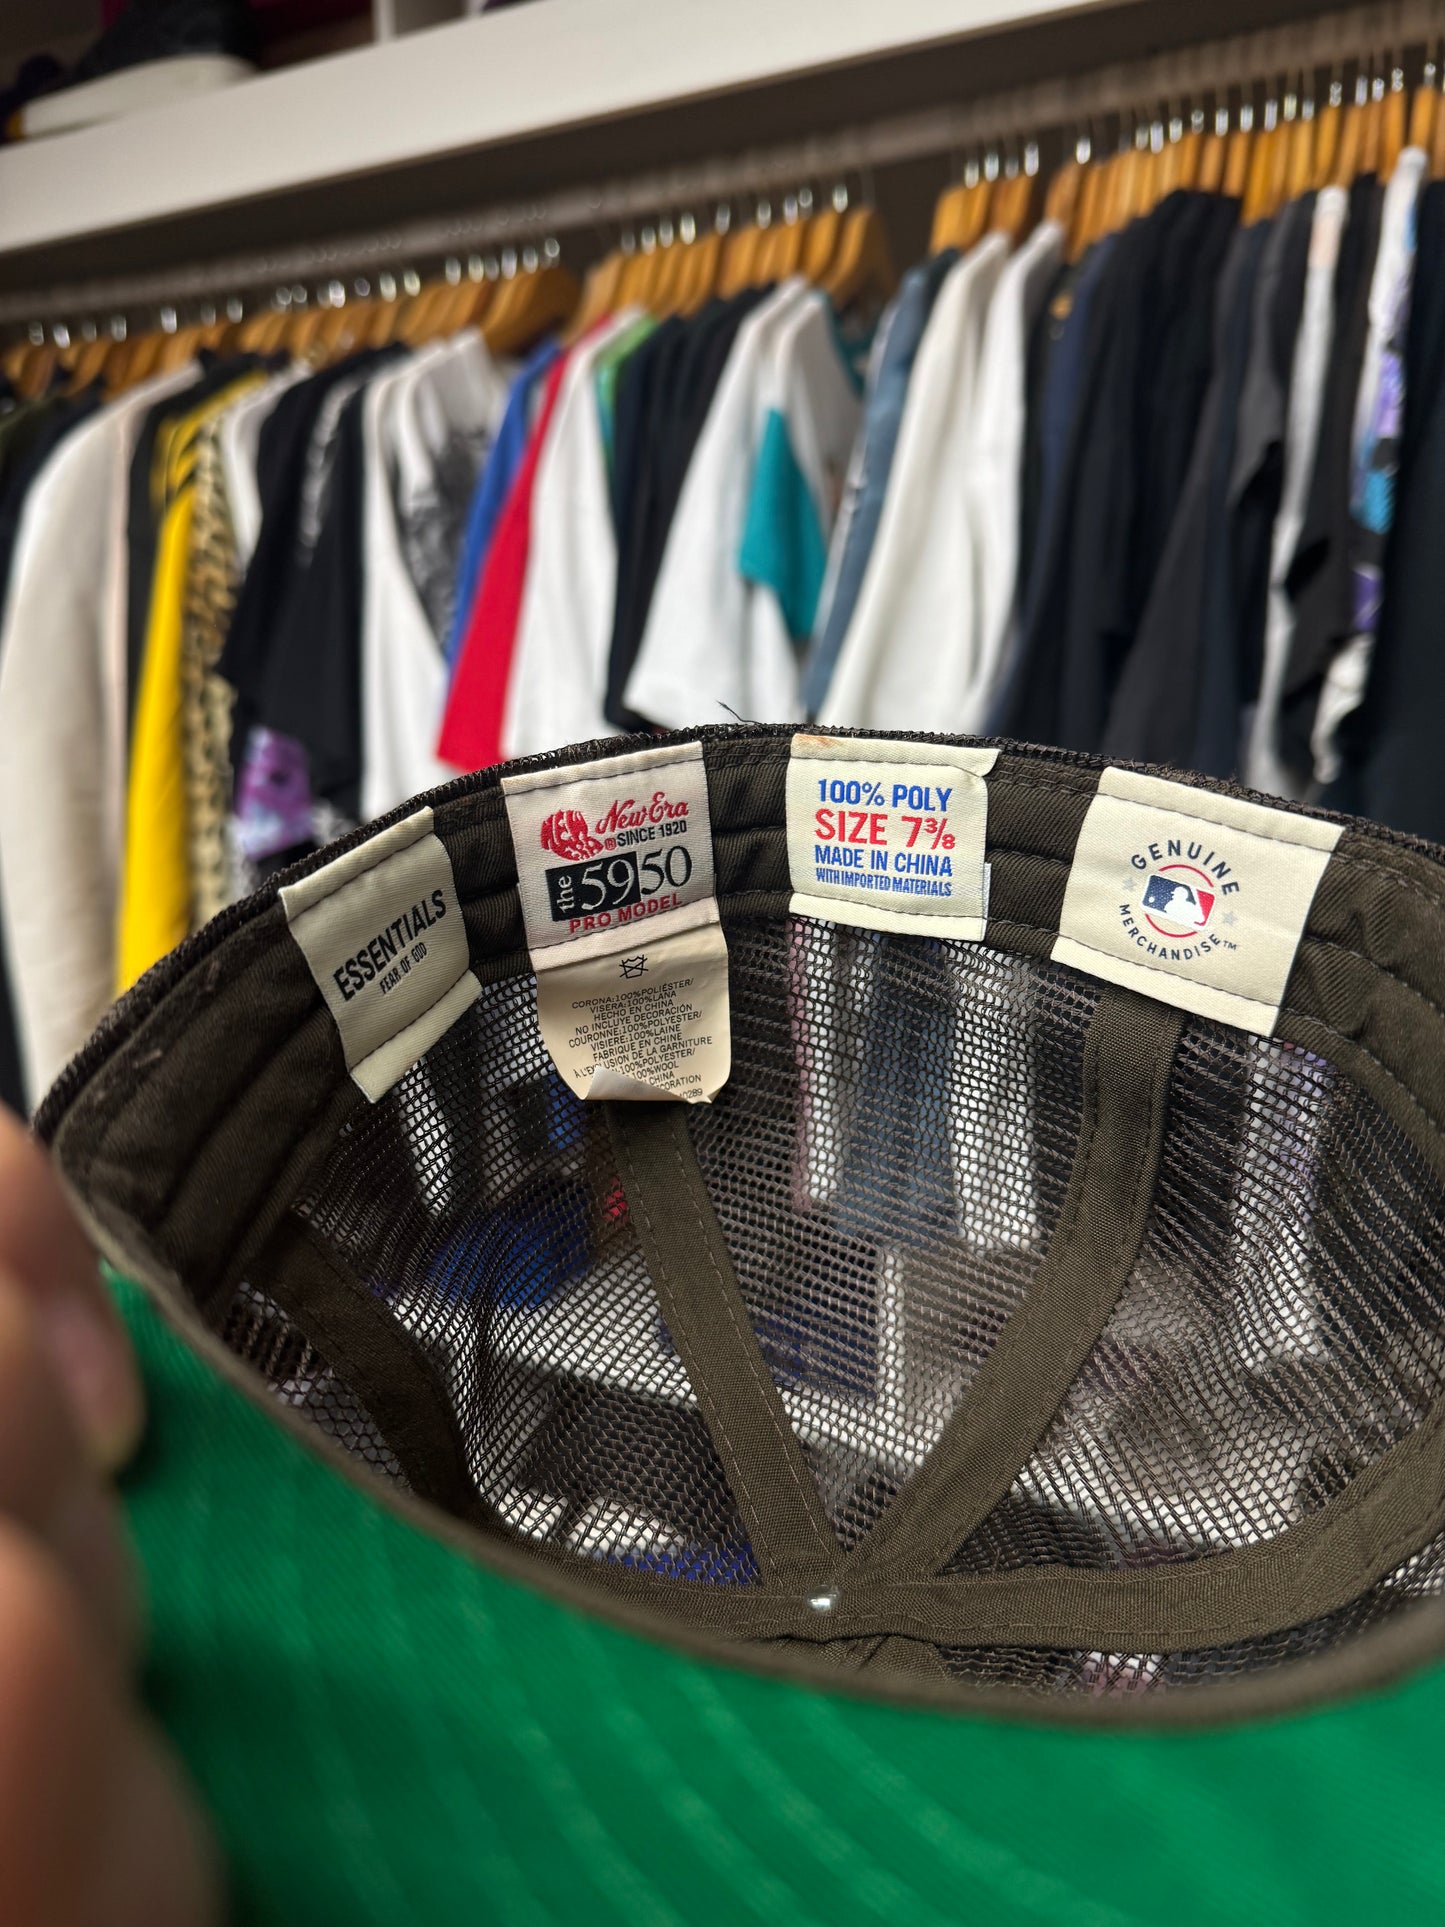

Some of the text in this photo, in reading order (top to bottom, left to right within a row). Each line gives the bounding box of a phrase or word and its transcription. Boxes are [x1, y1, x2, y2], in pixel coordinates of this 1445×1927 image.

[818, 778, 953, 812] 100% POLY
[616, 826, 656, 847] SINCE
[659, 820, 687, 838] 1920
[815, 808, 888, 846] SIZE
[815, 844, 953, 877] MADE IN CHINA
[1131, 839, 1240, 895] GENUINE
[556, 875, 575, 913] the
[815, 867, 952, 897] WITH IMPORTED MATERIALS
[569, 893, 683, 934] PRO MODEL
[333, 889, 447, 1001] ESSENTIALS
[1119, 904, 1221, 960] MERCHANDISE
[380, 942, 427, 994] FEAR OF GOD
[591, 991, 677, 1014] VISERA:100%LANA
[593, 999, 674, 1022] HECHO EN CHINA
[575, 1004, 693, 1036] NO INCLUYE DECORACIÓN
[593, 1032, 683, 1062] FABRIQUE EN CHINE
[632, 1051, 644, 1060] DE
[646, 1048, 658, 1057] LA
[660, 1036, 713, 1053] GARNITURE
[649, 1072, 675, 1086] CHINA
